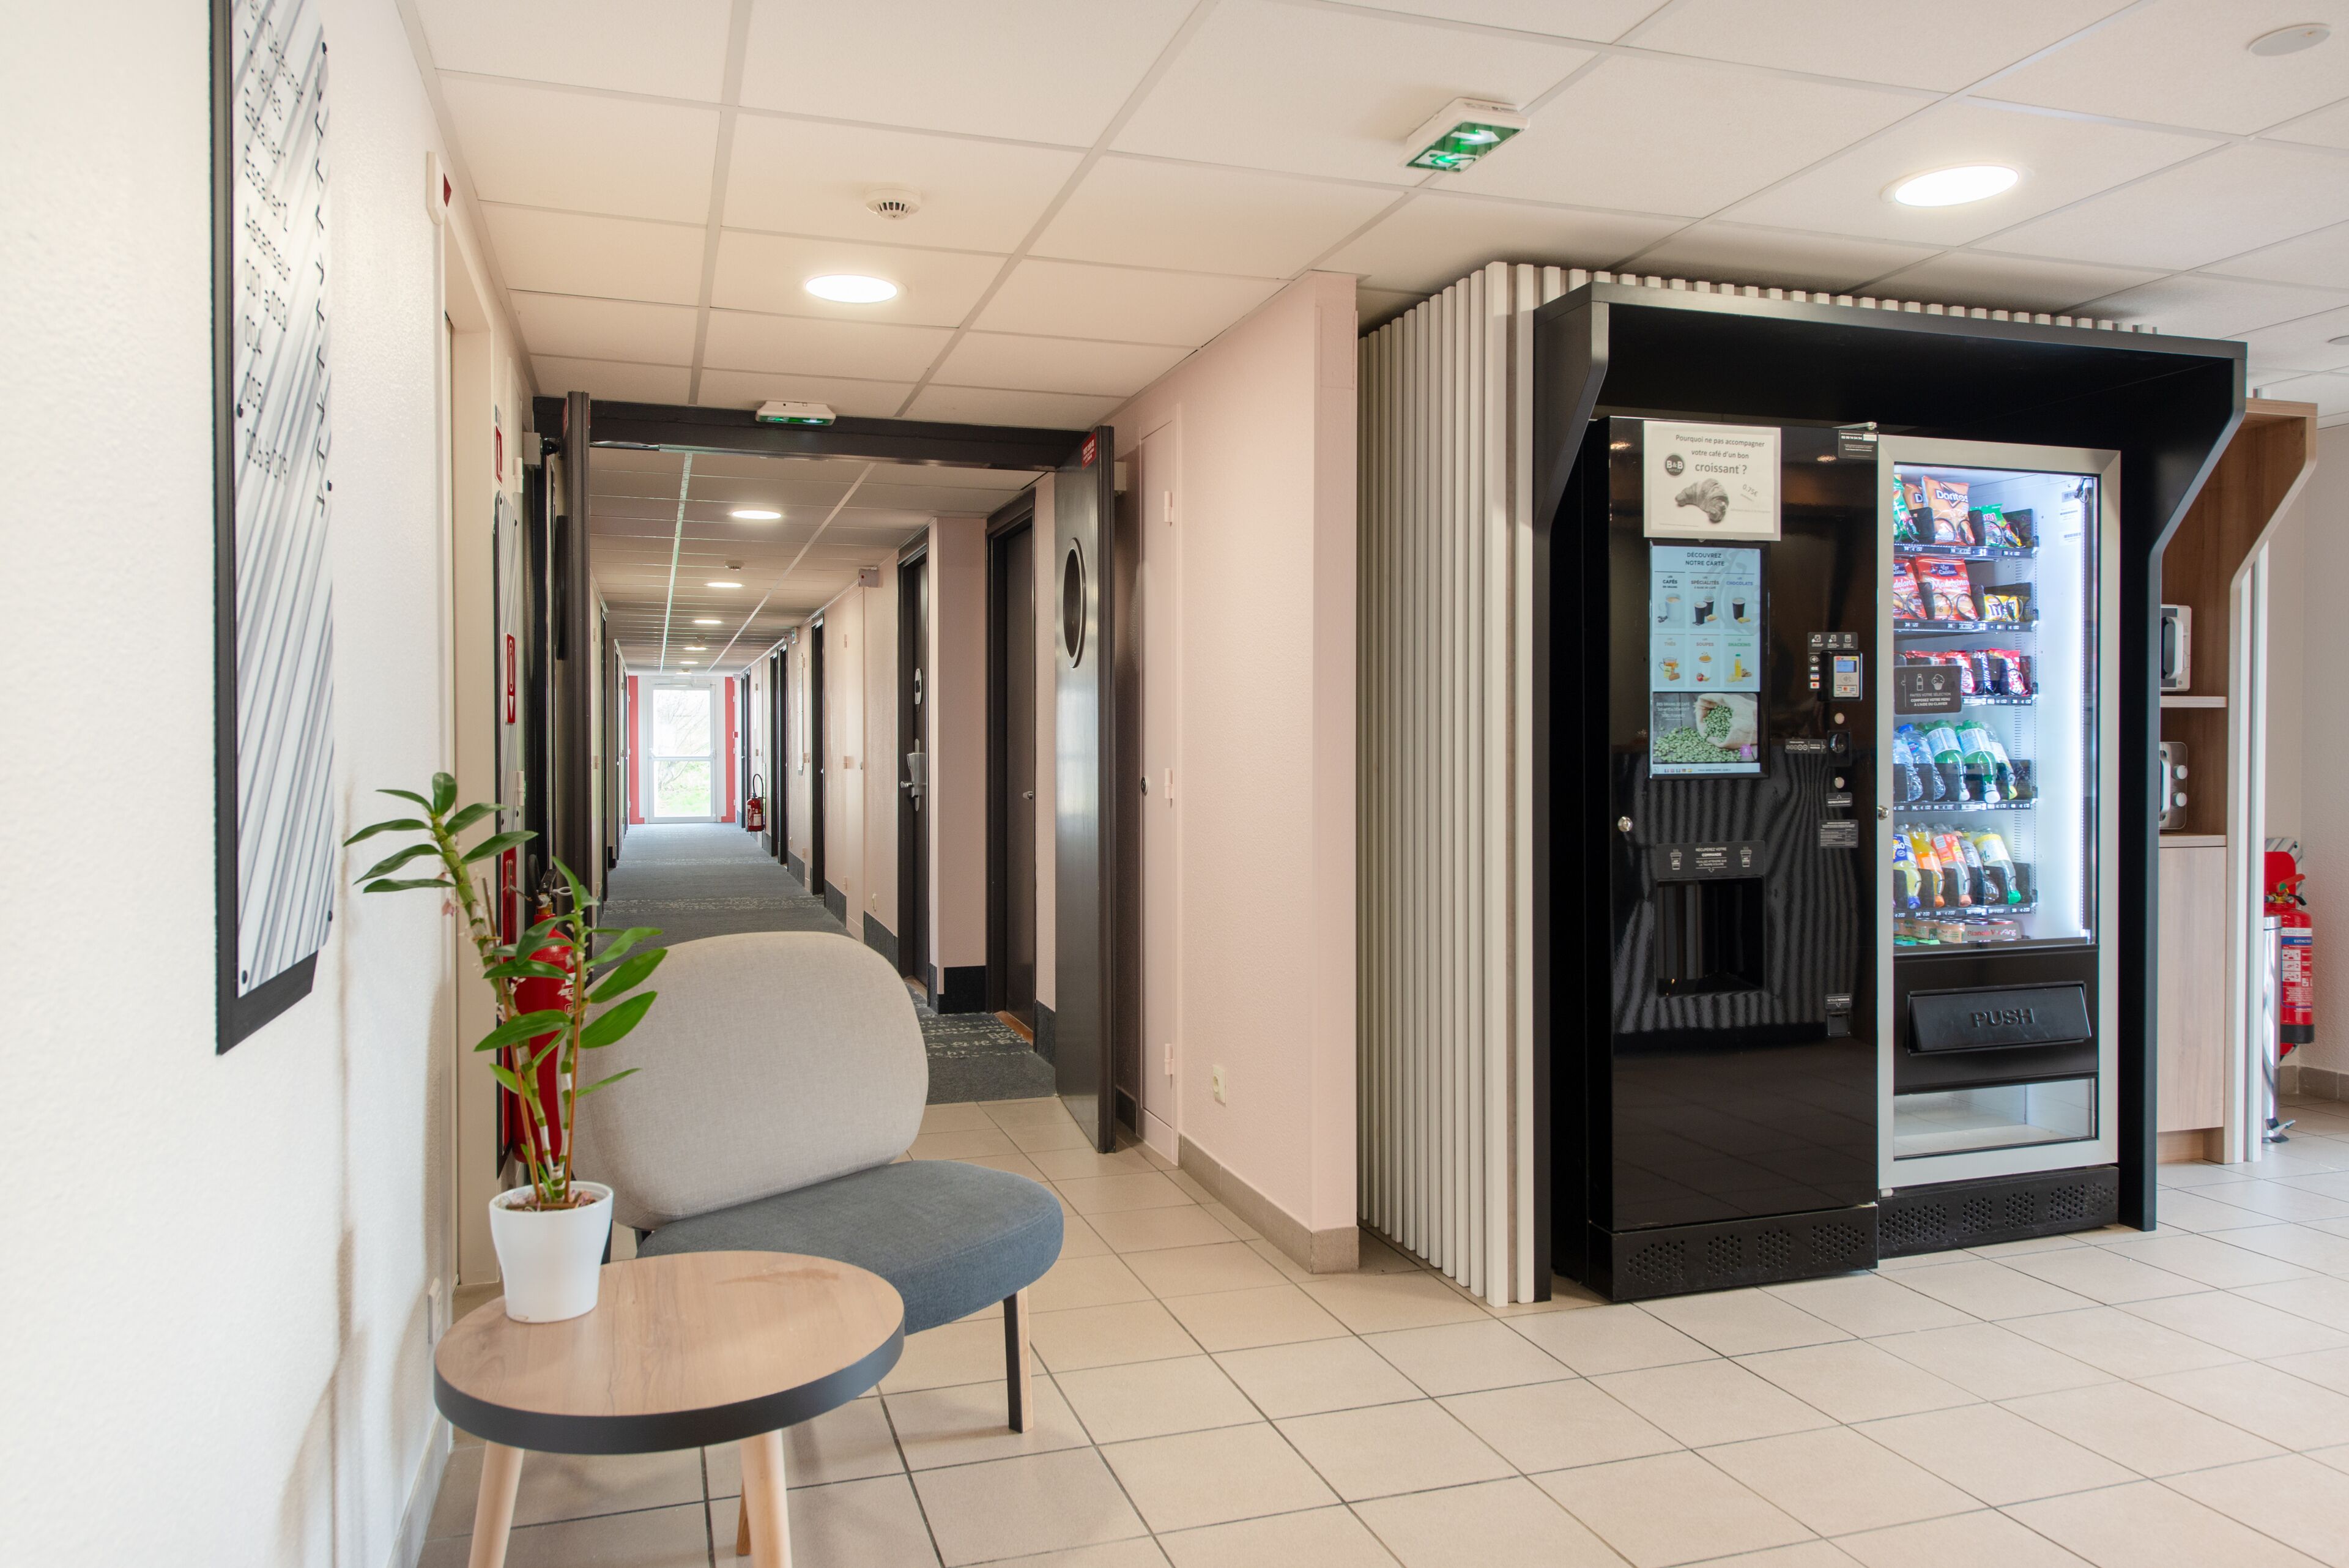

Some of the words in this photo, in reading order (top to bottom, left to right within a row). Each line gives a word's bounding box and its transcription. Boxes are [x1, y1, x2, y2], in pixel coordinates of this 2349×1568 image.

[245, 87, 281, 166] Escalier
[245, 144, 281, 218] Escalier
[283, 202, 288, 232] 2
[245, 203, 291, 283] Ascenseur
[245, 258, 261, 303] 001
[271, 290, 287, 332] 003
[245, 314, 262, 360] 004
[246, 371, 262, 414] 005
[246, 428, 262, 469] 006
[273, 449, 287, 486] 019
[1675, 434, 1703, 444] Pourquoi
[1725, 439, 1765, 448] accompagner
[1666, 460, 1683, 469] B&B
[1935, 489, 1969, 503] Doritos
[1970, 1008, 2035, 1028] PUSH
